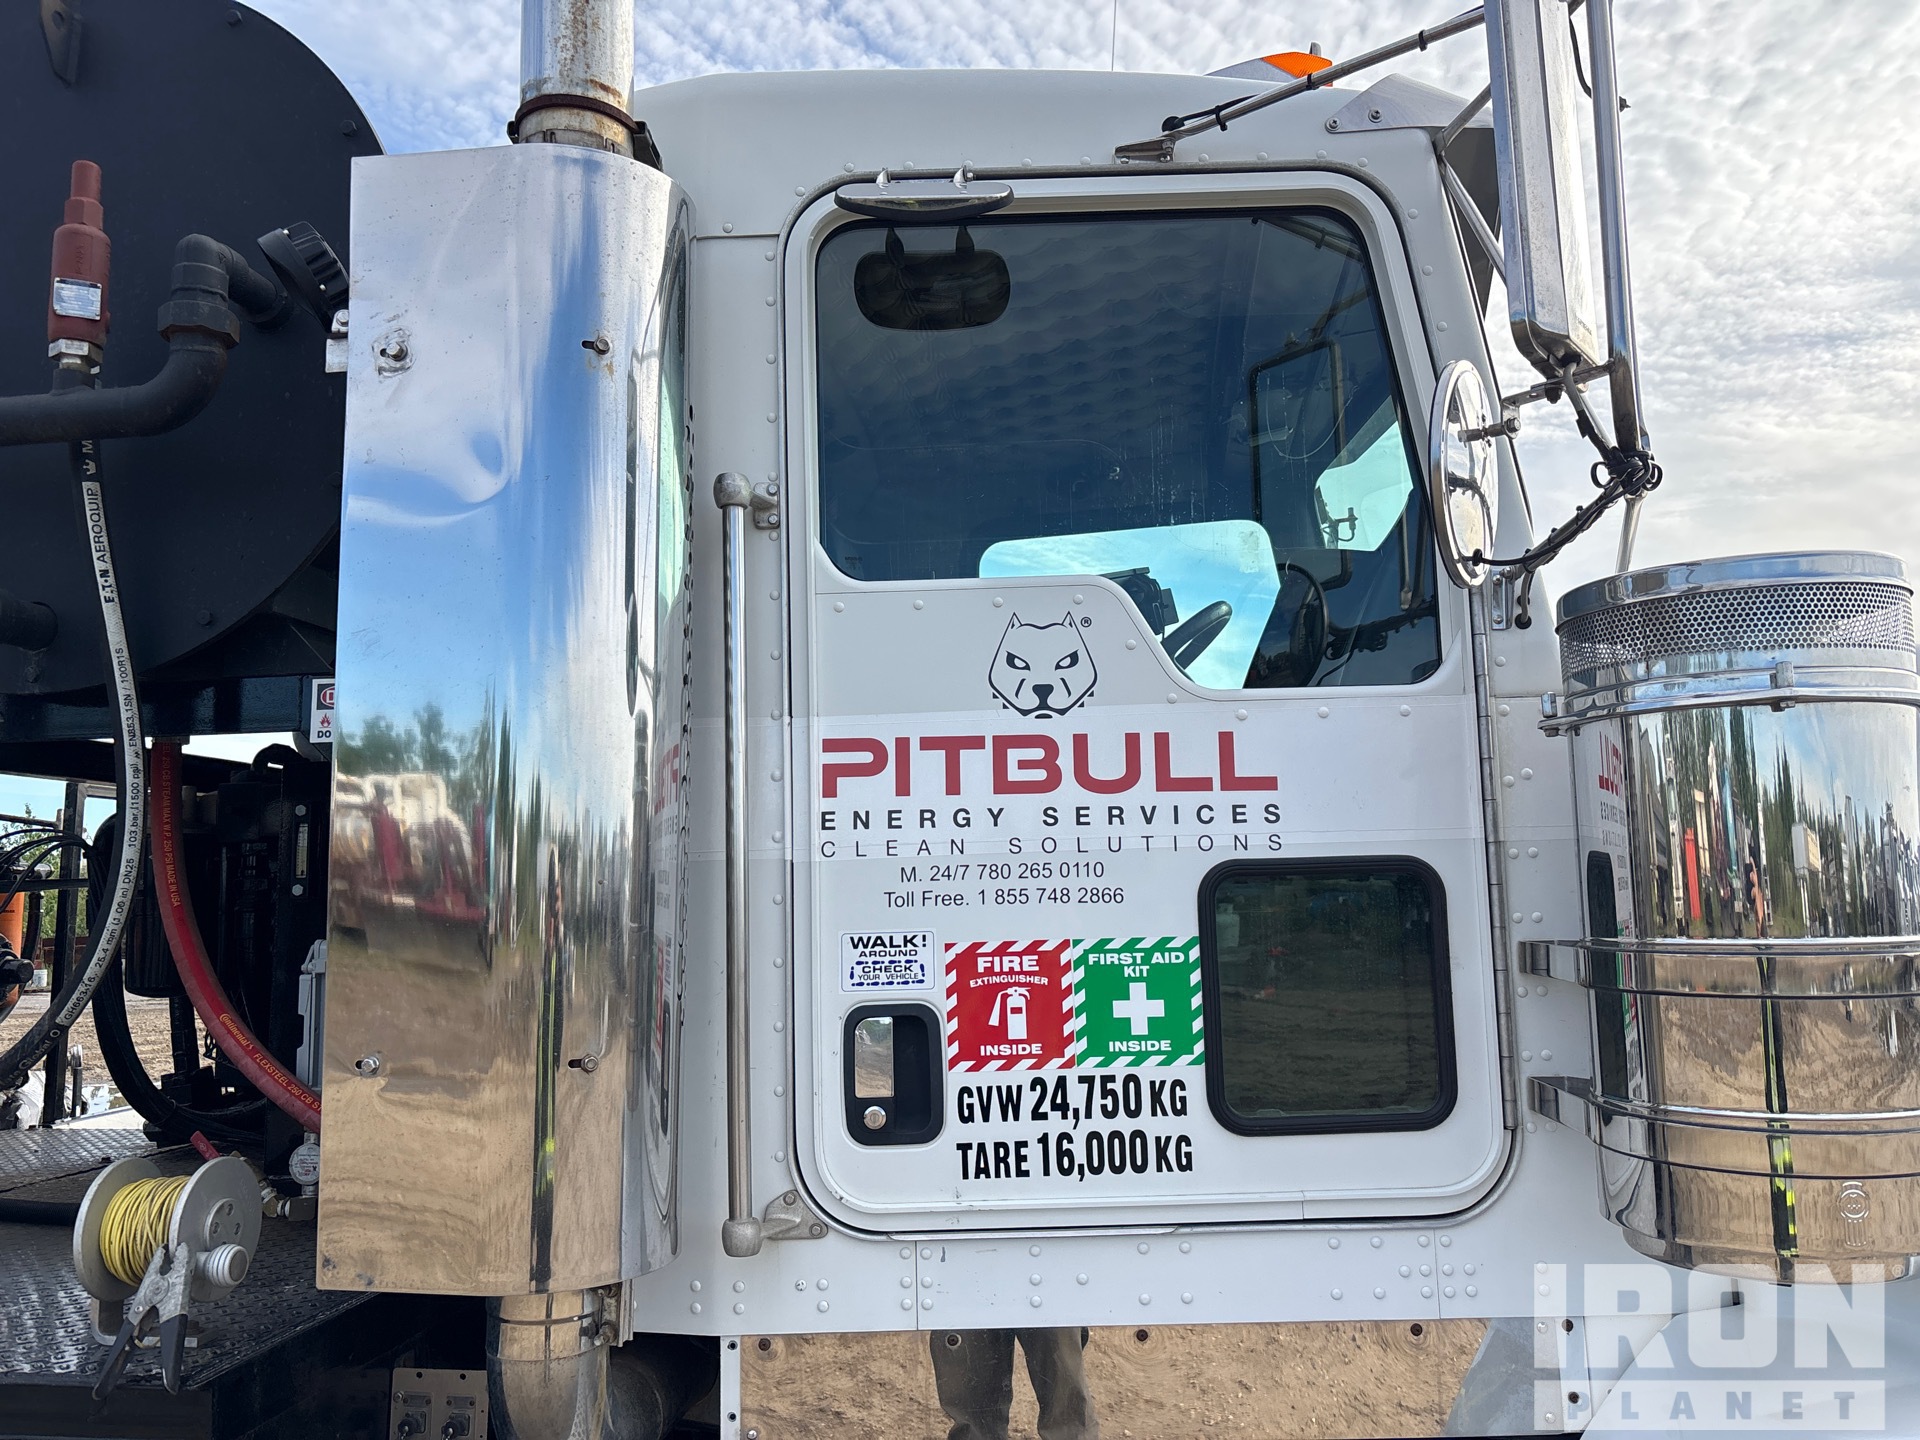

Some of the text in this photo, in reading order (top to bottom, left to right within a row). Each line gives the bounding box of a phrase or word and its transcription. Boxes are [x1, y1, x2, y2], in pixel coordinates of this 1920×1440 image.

[86, 487, 109, 564] AEROQUIP
[114, 648, 129, 684] 100R1S
[317, 730, 332, 739] DO
[821, 731, 1279, 799] PITBULL
[163, 808, 171, 823] MAX
[820, 803, 1283, 832] ENERGY SERVICES
[820, 834, 1283, 859] CLEAN SOLUTIONS
[165, 852, 174, 864] PSI
[123, 858, 135, 885] DN25
[166, 864, 177, 884] MADE
[900, 861, 1105, 883] M. 24/7 780 265 0110
[168, 884, 178, 892] IN
[170, 892, 181, 907] USA
[884, 887, 1125, 908] Toll Free. 1 855 748 2866
[107, 928, 118, 945] mm
[849, 934, 927, 950] WALK!
[858, 949, 918, 958] AROUND
[1088, 951, 1186, 966] FIRST AID
[861, 964, 914, 974] CHECK
[976, 955, 1040, 973] FIRE
[1123, 965, 1150, 978] KIT
[857, 972, 919, 981] YOUR VEHICLE
[969, 974, 1049, 989] EXTINGUISHER
[979, 1043, 1043, 1057] INSIDE
[1108, 1039, 1172, 1053] INSIDE
[253, 1053, 289, 1087] FLEXSTEEL
[288, 1083, 302, 1096] 250
[300, 1093, 313, 1104] CB
[957, 1073, 1188, 1130] GVW 24,750 KG
[956, 1129, 1194, 1182] TARE 16,000 KG
